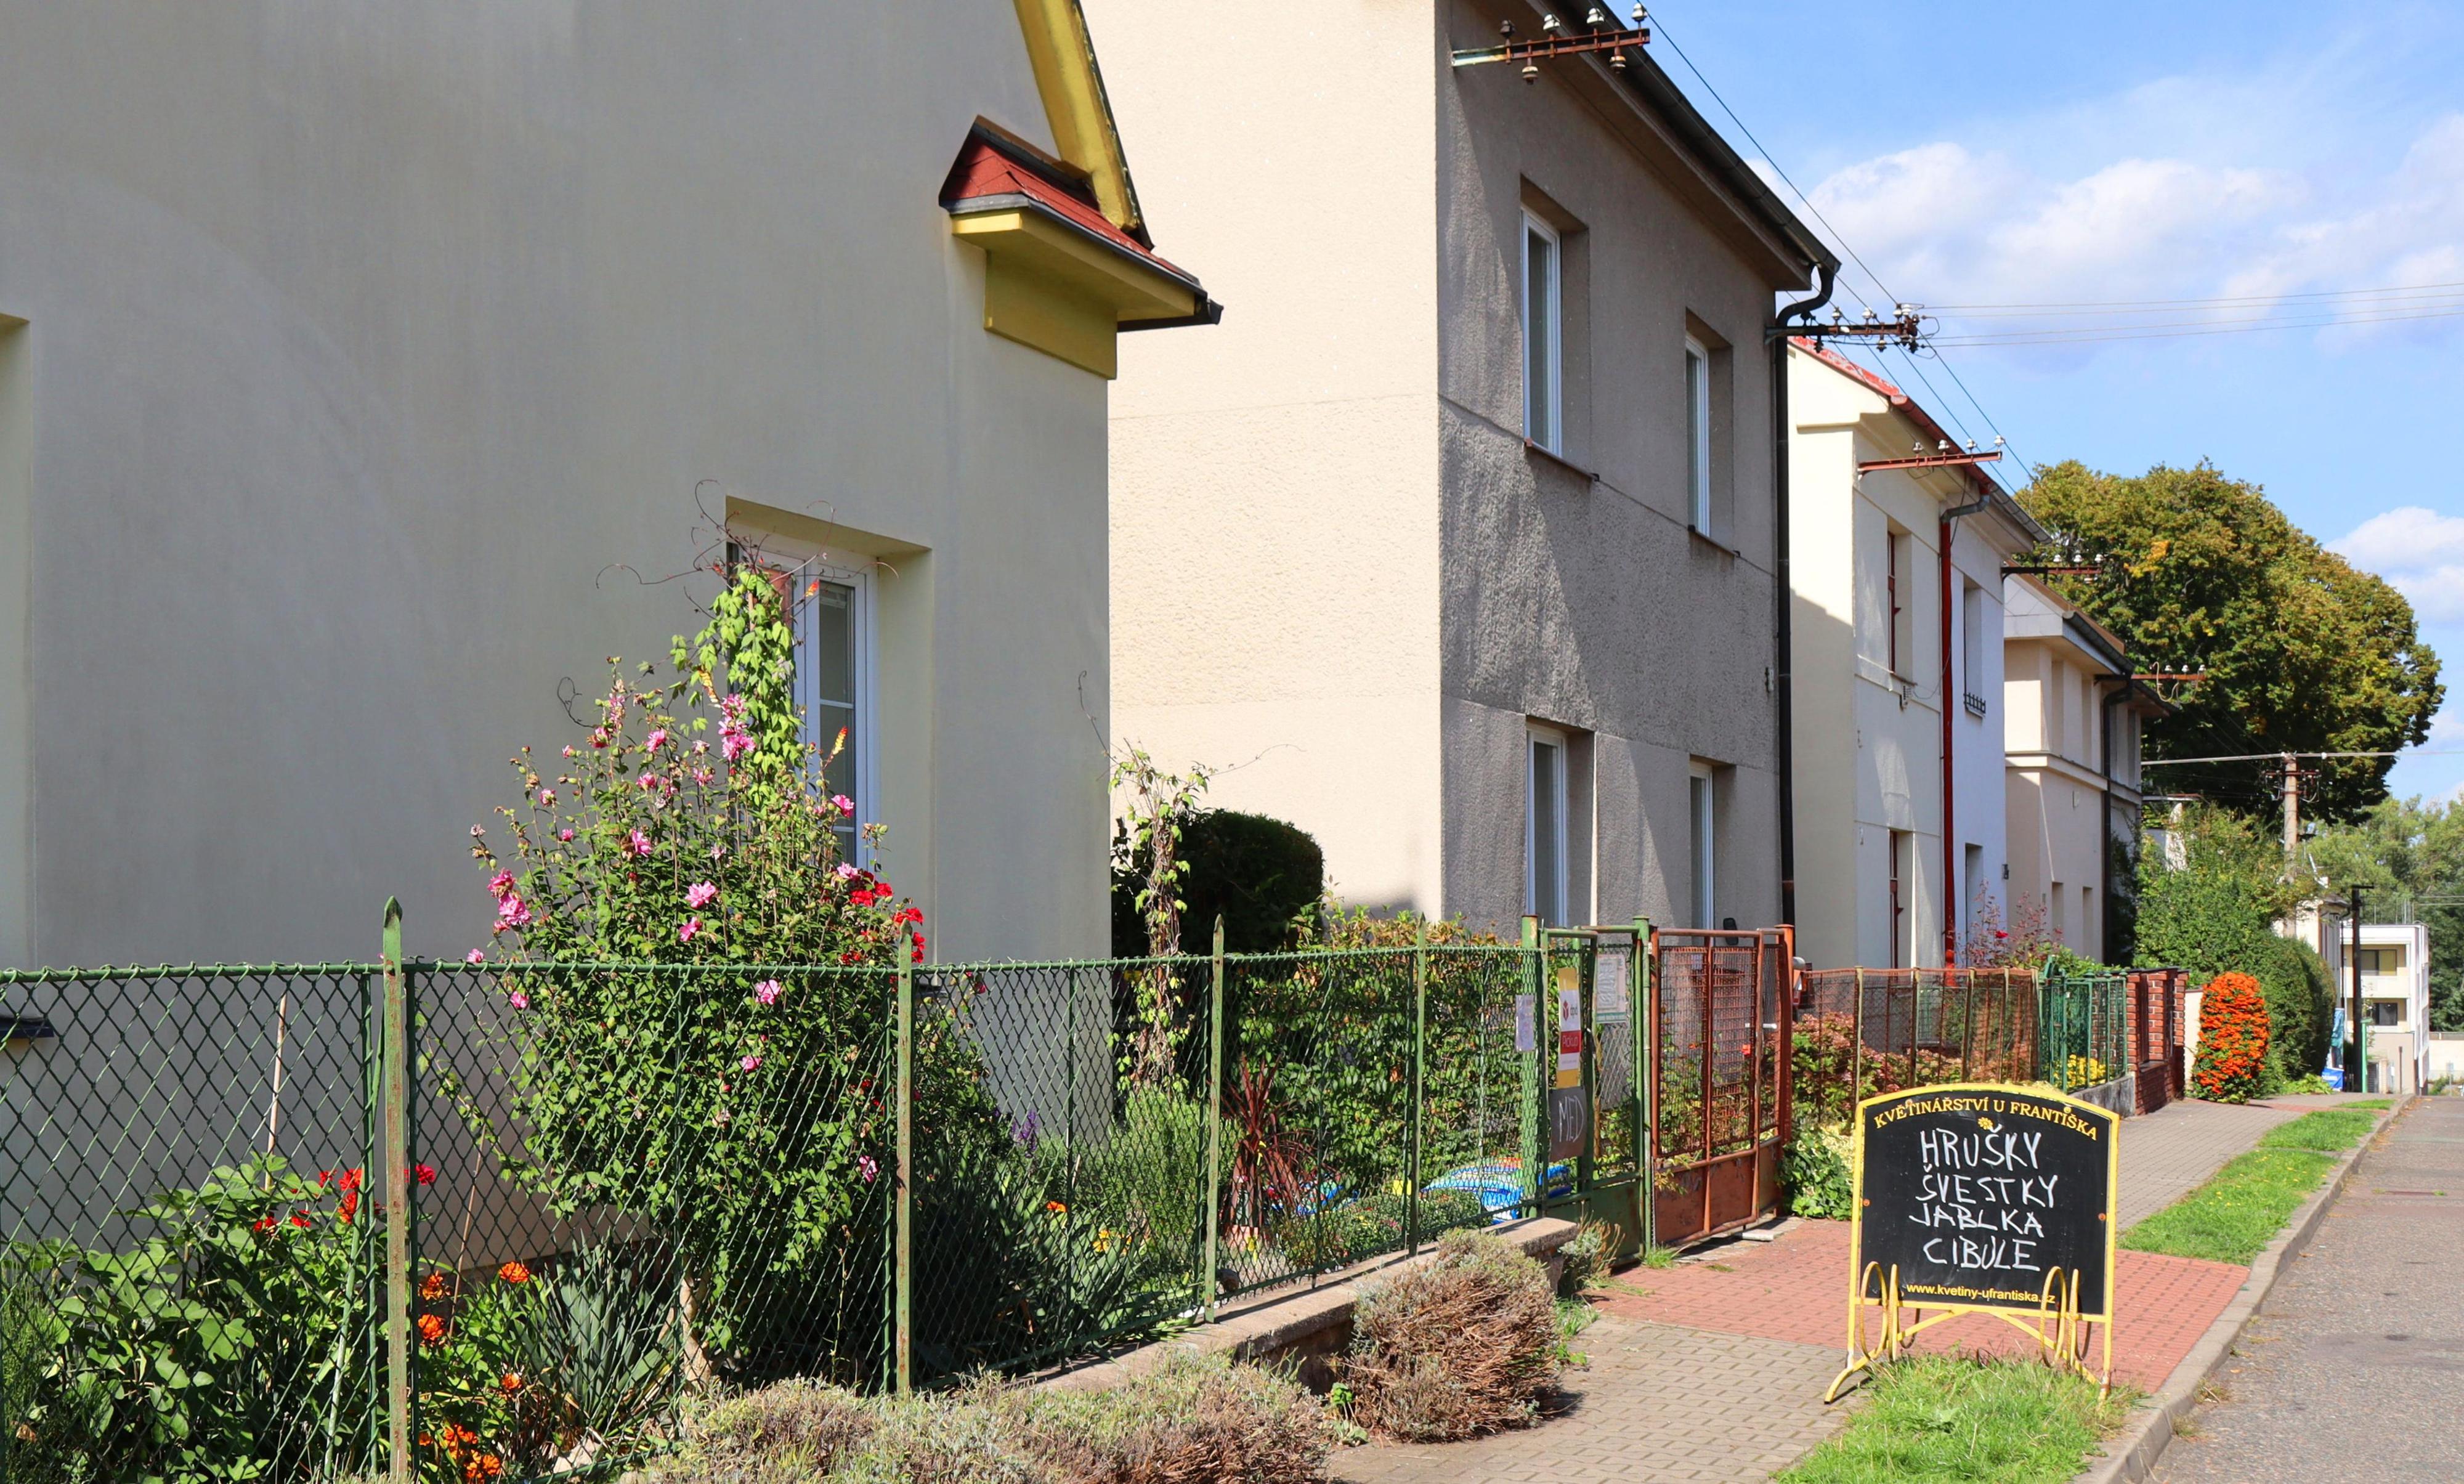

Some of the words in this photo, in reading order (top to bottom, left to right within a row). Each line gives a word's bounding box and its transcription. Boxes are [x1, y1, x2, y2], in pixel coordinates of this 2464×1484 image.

[1558, 1095, 1584, 1143] MED
[1874, 1097, 1989, 1129] KVĚTINÁŘSTVÍ
[1993, 1100, 2006, 1113] U
[2009, 1101, 2097, 1141] FRANTIŠKA
[1920, 1123, 2041, 1172] HRUŠKY
[1915, 1162, 2058, 1208] ŠVESTKY
[1909, 1202, 2044, 1238] JABLKA
[1923, 1235, 2040, 1271] CIBULE
[1907, 1283, 2056, 1304] www.kvetiny-ufrantiska.z
